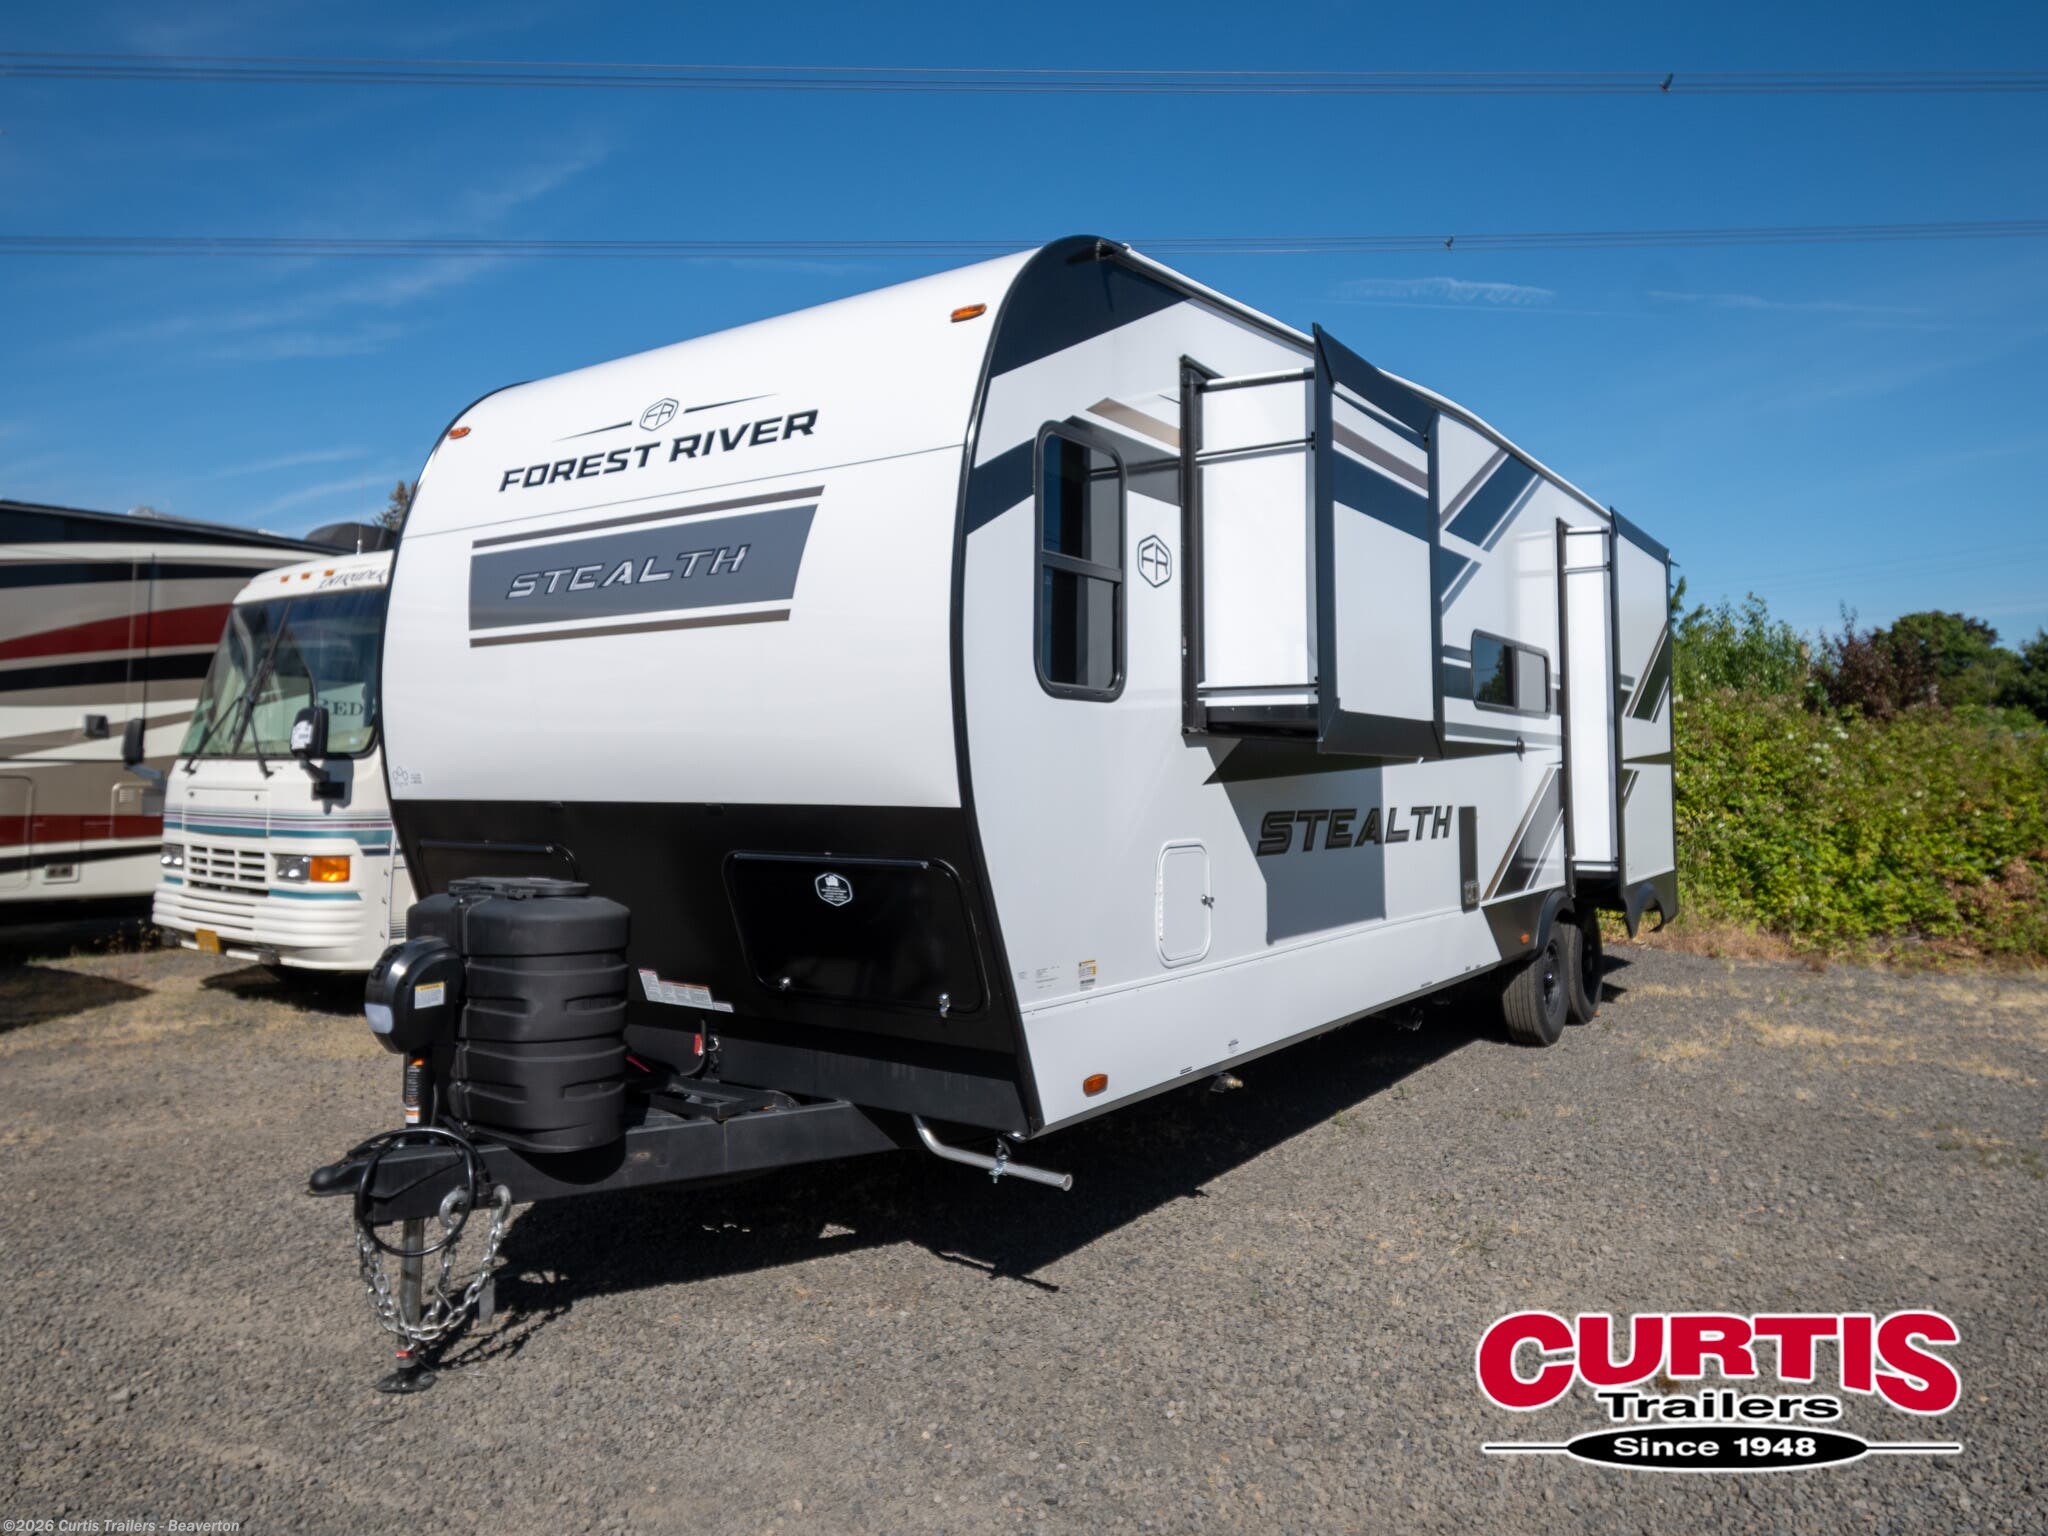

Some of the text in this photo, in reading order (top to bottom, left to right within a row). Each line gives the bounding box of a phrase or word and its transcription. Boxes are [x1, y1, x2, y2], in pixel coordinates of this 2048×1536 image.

[498, 409, 818, 492] FOREST RIVER
[505, 543, 751, 599] STEALTH
[1256, 805, 1453, 857] STEALTH
